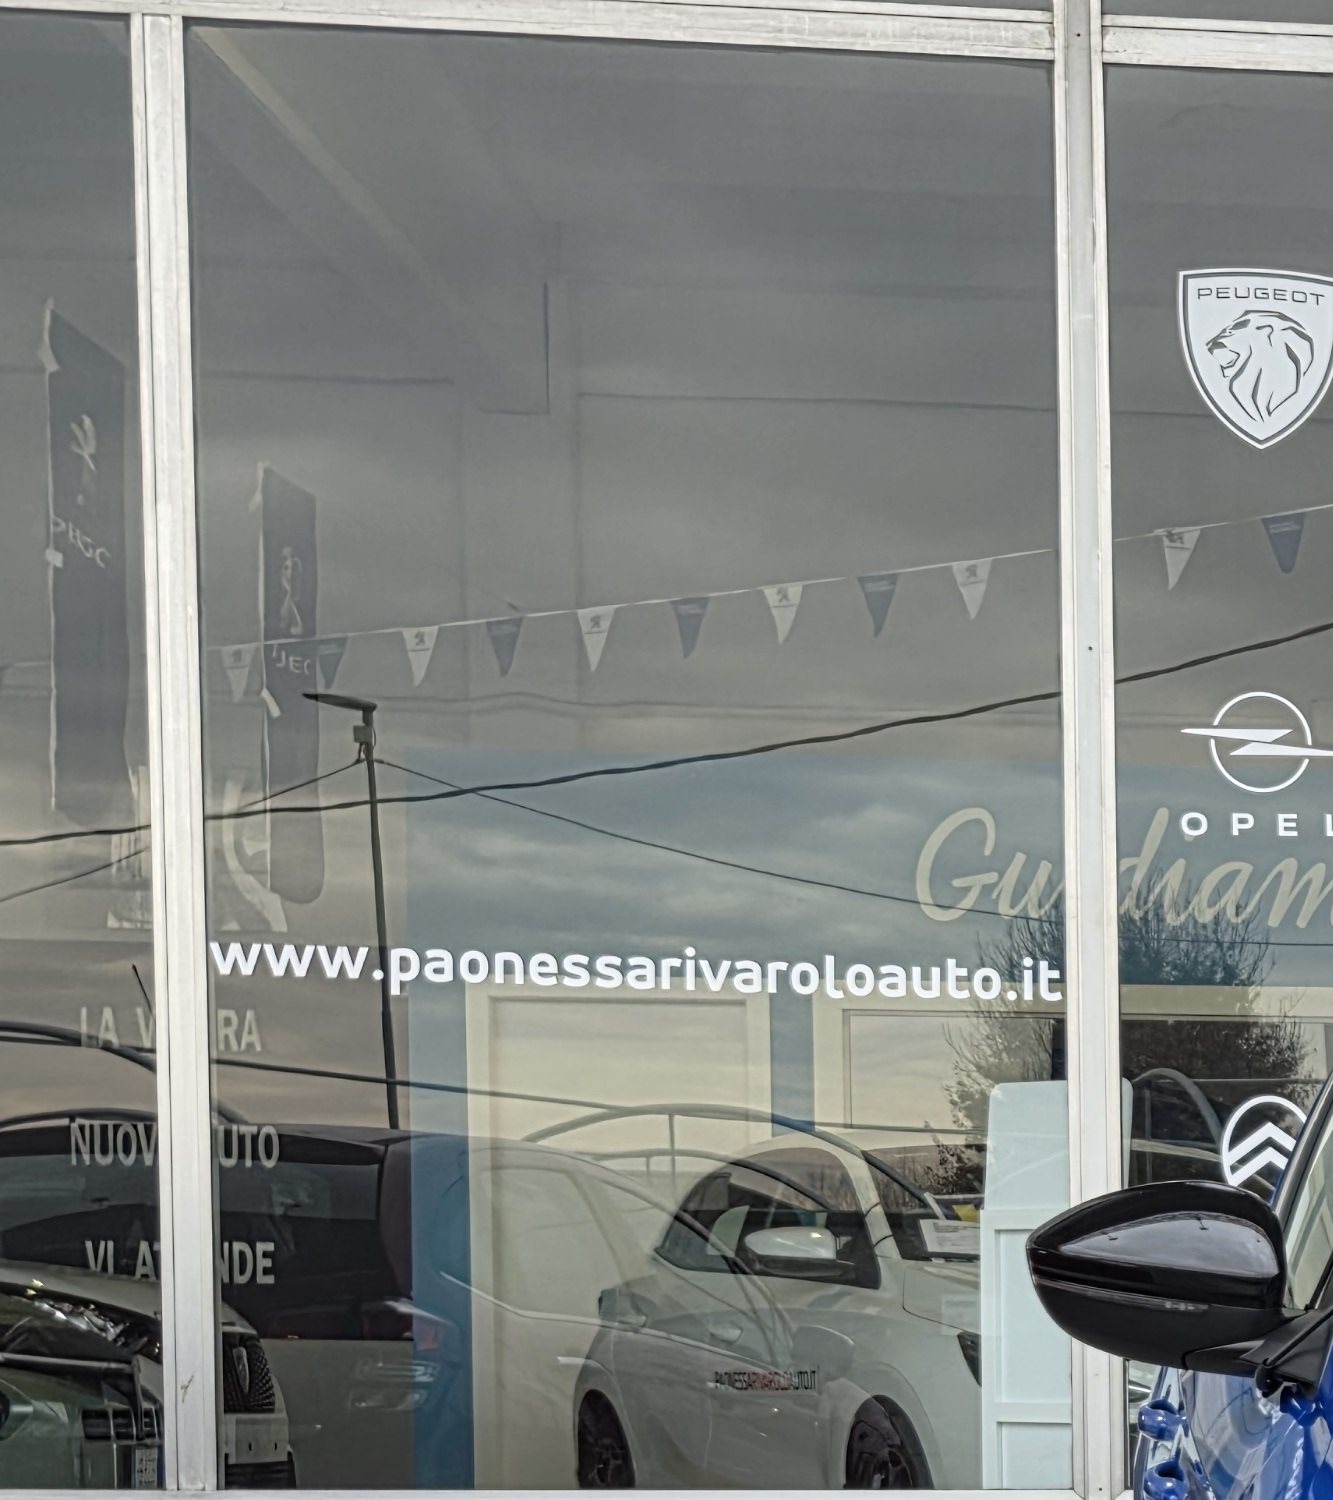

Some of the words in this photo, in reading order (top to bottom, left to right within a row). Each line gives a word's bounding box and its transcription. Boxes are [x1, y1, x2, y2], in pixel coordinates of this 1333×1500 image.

[1196, 286, 1326, 307] PEUGEOT
[210, 940, 1063, 1002] www.paonessarivaroloauto.it
[80, 1006, 119, 1048] LA
[70, 1122, 157, 1167] NUOV
[217, 1124, 280, 1168] UTO
